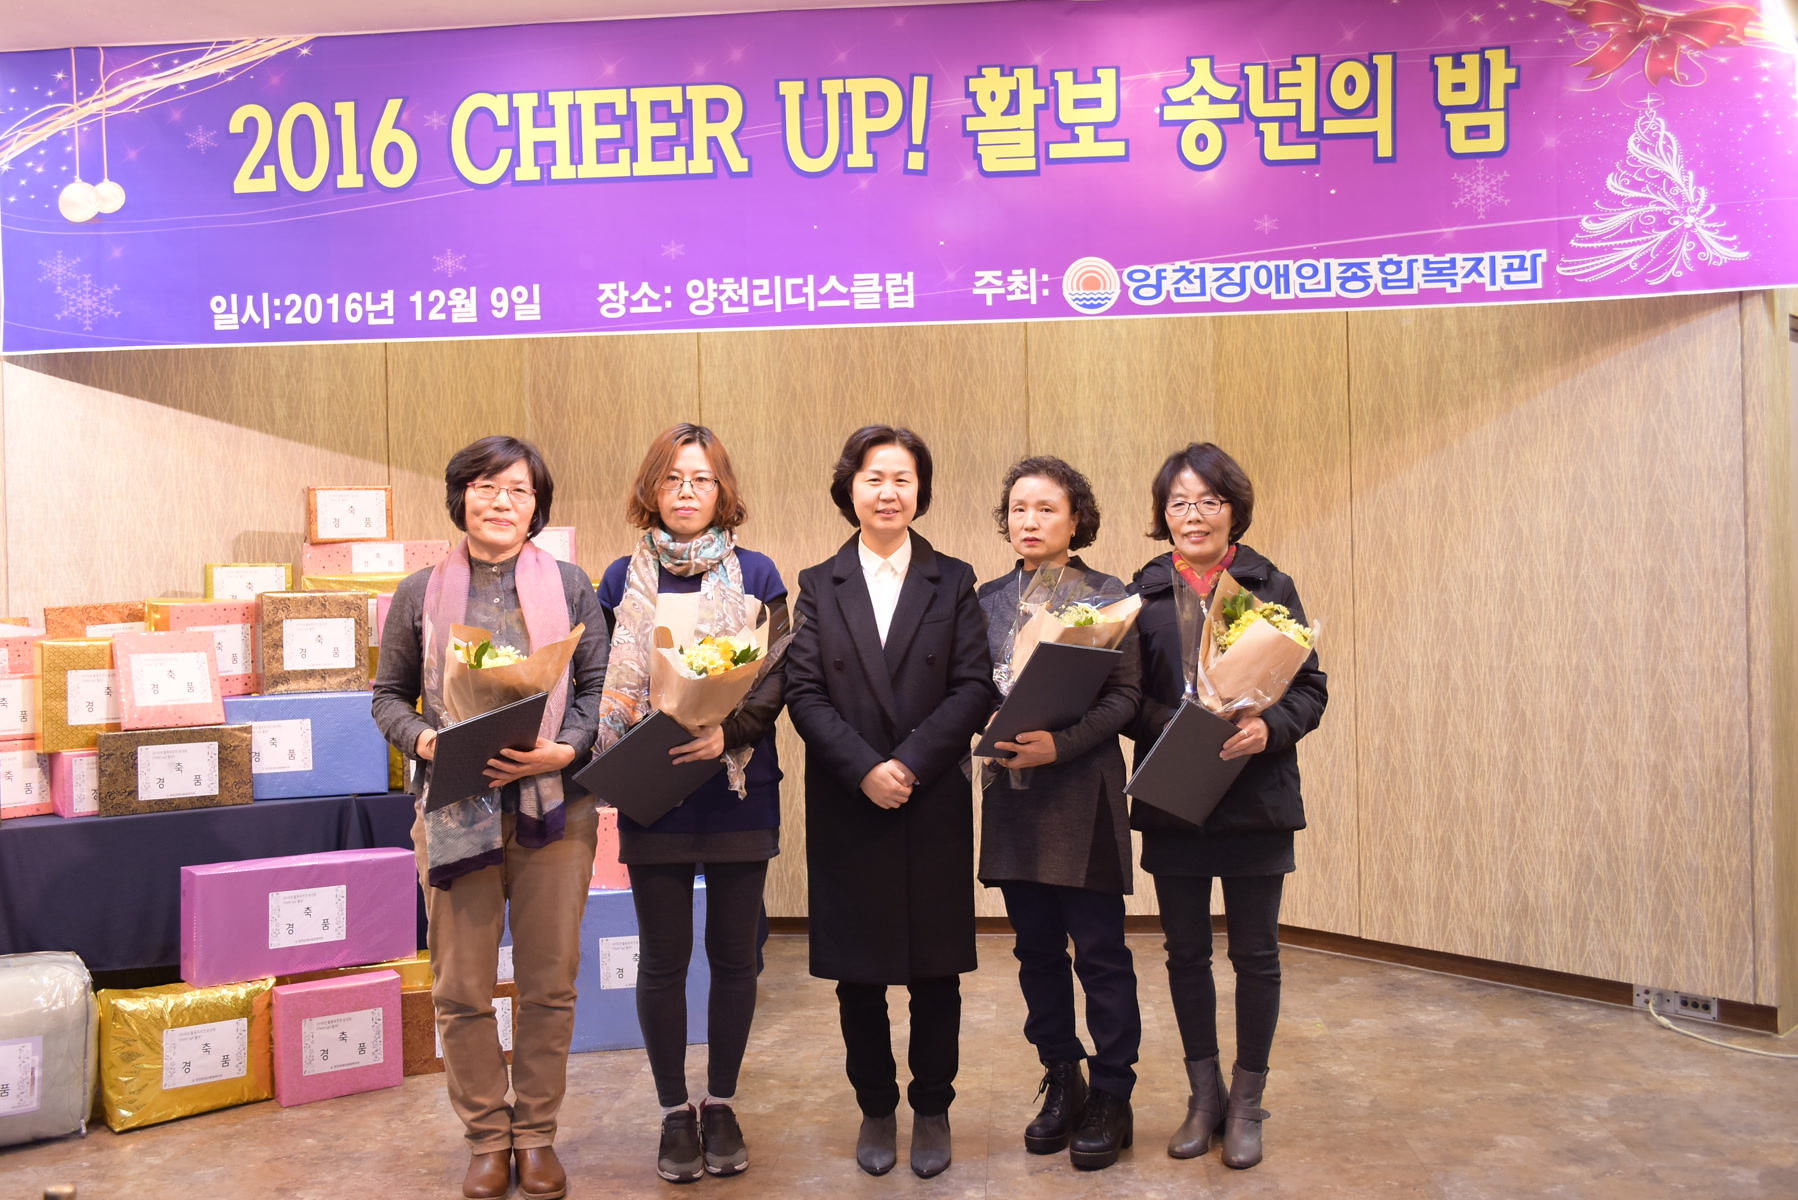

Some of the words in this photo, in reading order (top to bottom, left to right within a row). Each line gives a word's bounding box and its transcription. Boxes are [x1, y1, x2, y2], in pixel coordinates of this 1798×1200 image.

[229, 97, 418, 194] 2016
[451, 84, 749, 184] CHEER
[779, 75, 930, 173] UP!
[966, 67, 1125, 173] 활보
[1164, 55, 1394, 165] 송년의
[1434, 48, 1517, 155] 밤
[972, 266, 1050, 308] 주최:
[1125, 250, 1545, 304] 양천장애인종합복지관
[597, 280, 672, 320] 장소:
[686, 270, 916, 317] 양천리더스클럽
[210, 291, 395, 332] 일시:2016년
[408, 285, 479, 324] 12월
[490, 285, 542, 322] 9일
[315, 634, 324, 645] 축
[299, 648, 307, 659] 경
[332, 646, 340, 658] 품
[166, 669, 176, 680] 축
[104, 686, 112, 697] 축
[150, 683, 159, 695] 경
[186, 681, 195, 693] 품
[86, 701, 94, 713] 경
[269, 737, 278, 748] 축
[252, 751, 261, 763] 경
[288, 749, 296, 761] 품
[174, 762, 184, 774] 축
[156, 777, 165, 790] 경
[193, 774, 203, 787] 품
[303, 906, 312, 918] 축
[285, 922, 294, 935] 경
[321, 918, 330, 931] 품
[616, 967, 624, 979] 경
[338, 1031, 348, 1043] 축
[201, 1042, 212, 1055] 축
[320, 1048, 329, 1061] 경
[357, 1042, 367, 1055] 품
[182, 1060, 191, 1074] 경
[221, 1054, 230, 1068] 품
[0, 1083, 10, 1098] 품
